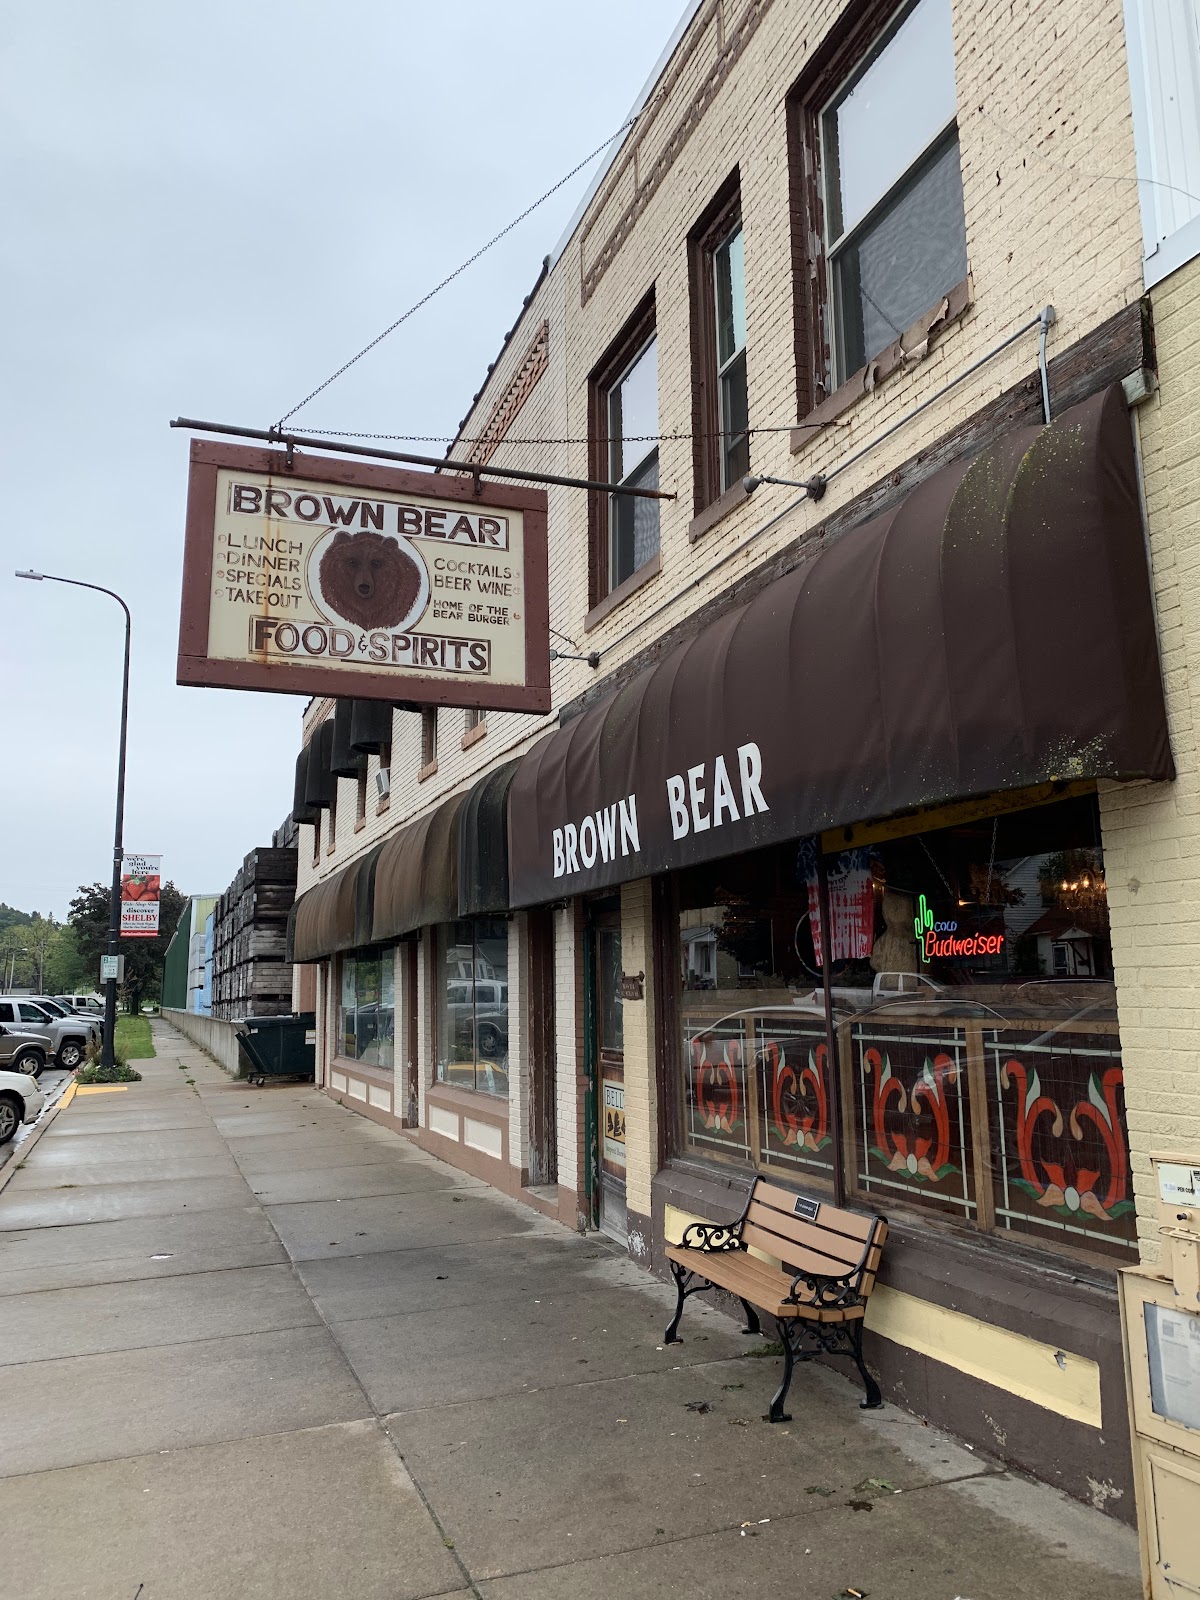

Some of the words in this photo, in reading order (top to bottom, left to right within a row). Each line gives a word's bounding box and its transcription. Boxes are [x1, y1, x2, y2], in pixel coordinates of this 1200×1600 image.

[233, 485, 385, 530] BROWN
[398, 507, 501, 545] BEAR
[227, 533, 303, 555] LUNCH
[226, 552, 301, 573] DINNER
[433, 558, 512, 579] COCKTAILS
[226, 569, 302, 591] SPECIALS
[434, 575, 472, 592] BEER
[477, 581, 513, 597] WINE
[433, 600, 463, 612] HOME
[468, 603, 483, 614] OF
[486, 605, 509, 616] THE
[433, 610, 464, 621] BEAR
[468, 613, 511, 626] BURGER
[254, 621, 356, 656] FOOD
[368, 632, 488, 672] SPIRITS
[552, 794, 641, 878] BROWN
[666, 742, 770, 841] BEAR
[934, 921, 957, 932] COLD
[925, 931, 1004, 957] Budweiser
